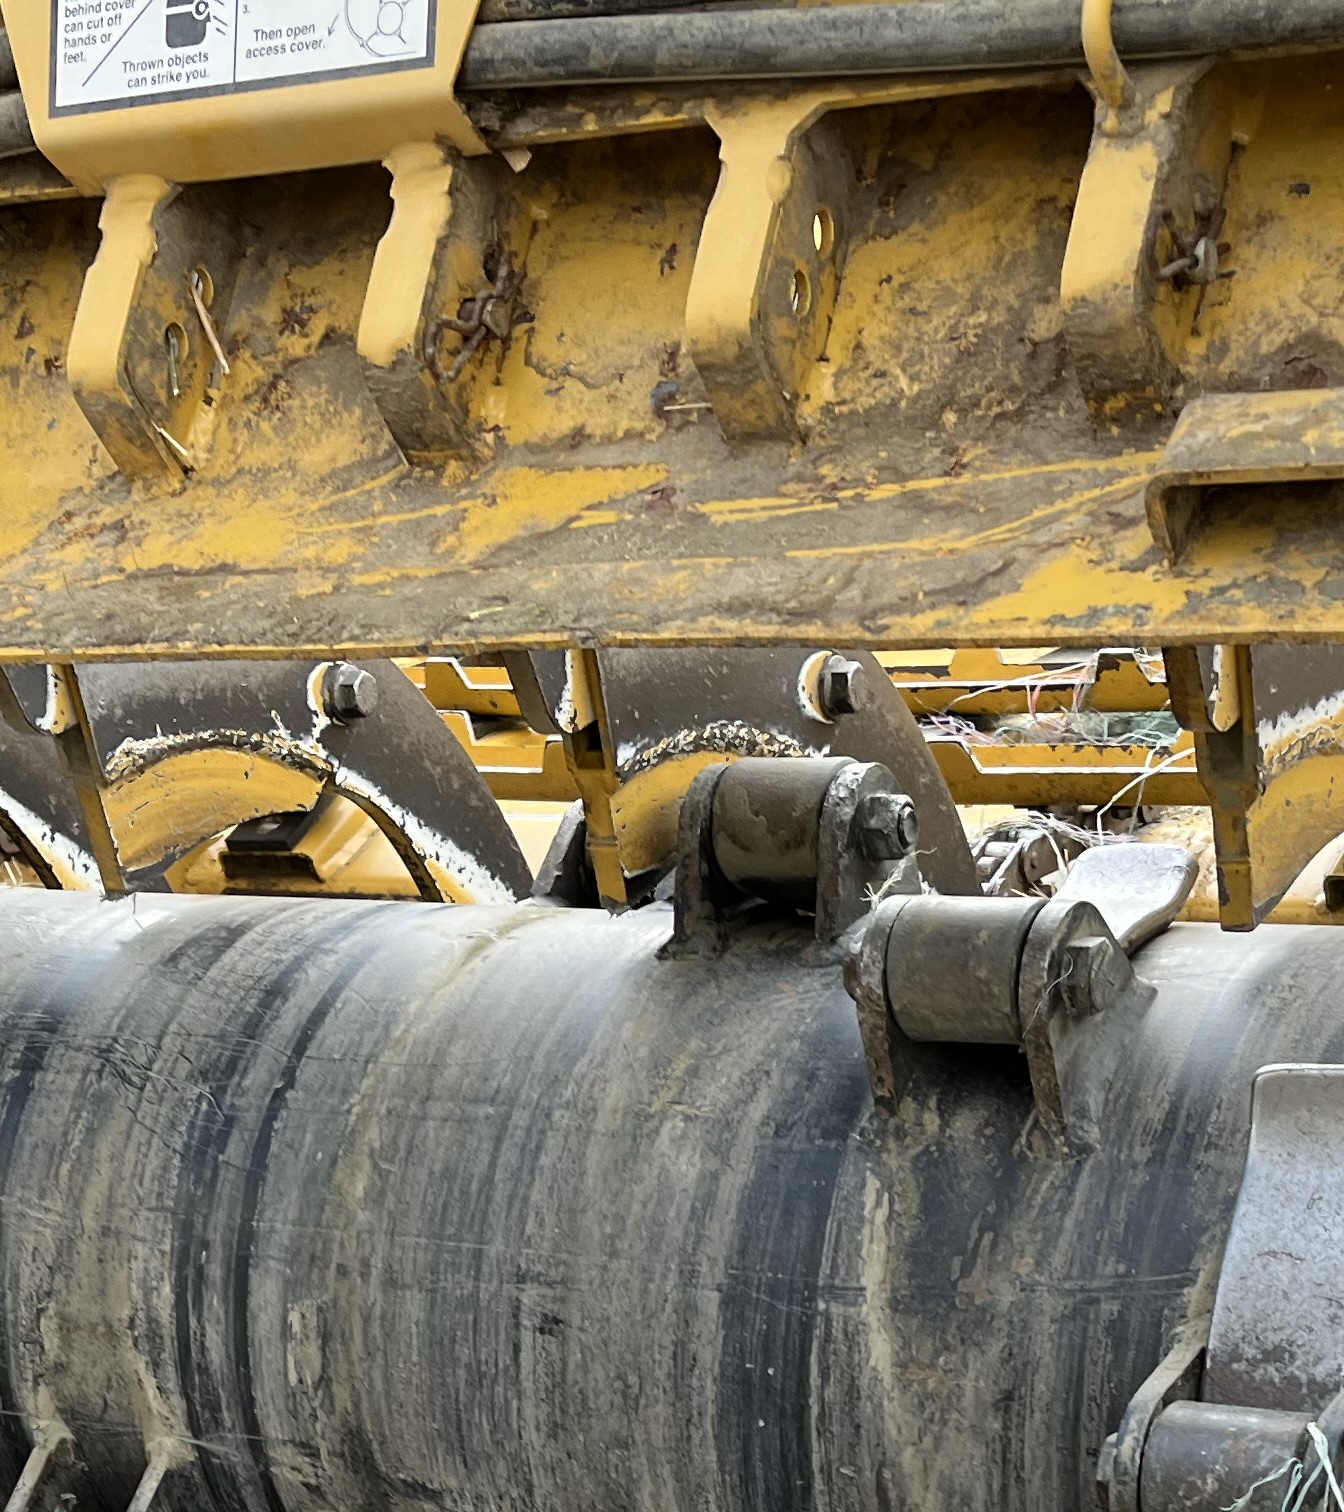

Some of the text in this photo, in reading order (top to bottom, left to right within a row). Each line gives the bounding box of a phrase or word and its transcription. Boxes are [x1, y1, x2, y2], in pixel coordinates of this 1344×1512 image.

[65, 0, 135, 18] behind cover
[242, 4, 250, 14] 3.
[64, 14, 122, 34] can cut off
[253, 23, 316, 42] Then open
[64, 32, 113, 49] hands or
[245, 38, 326, 59] access cover.
[63, 51, 87, 65] feet.
[122, 51, 209, 73] Thrown objects
[127, 69, 210, 88] can strike you.
